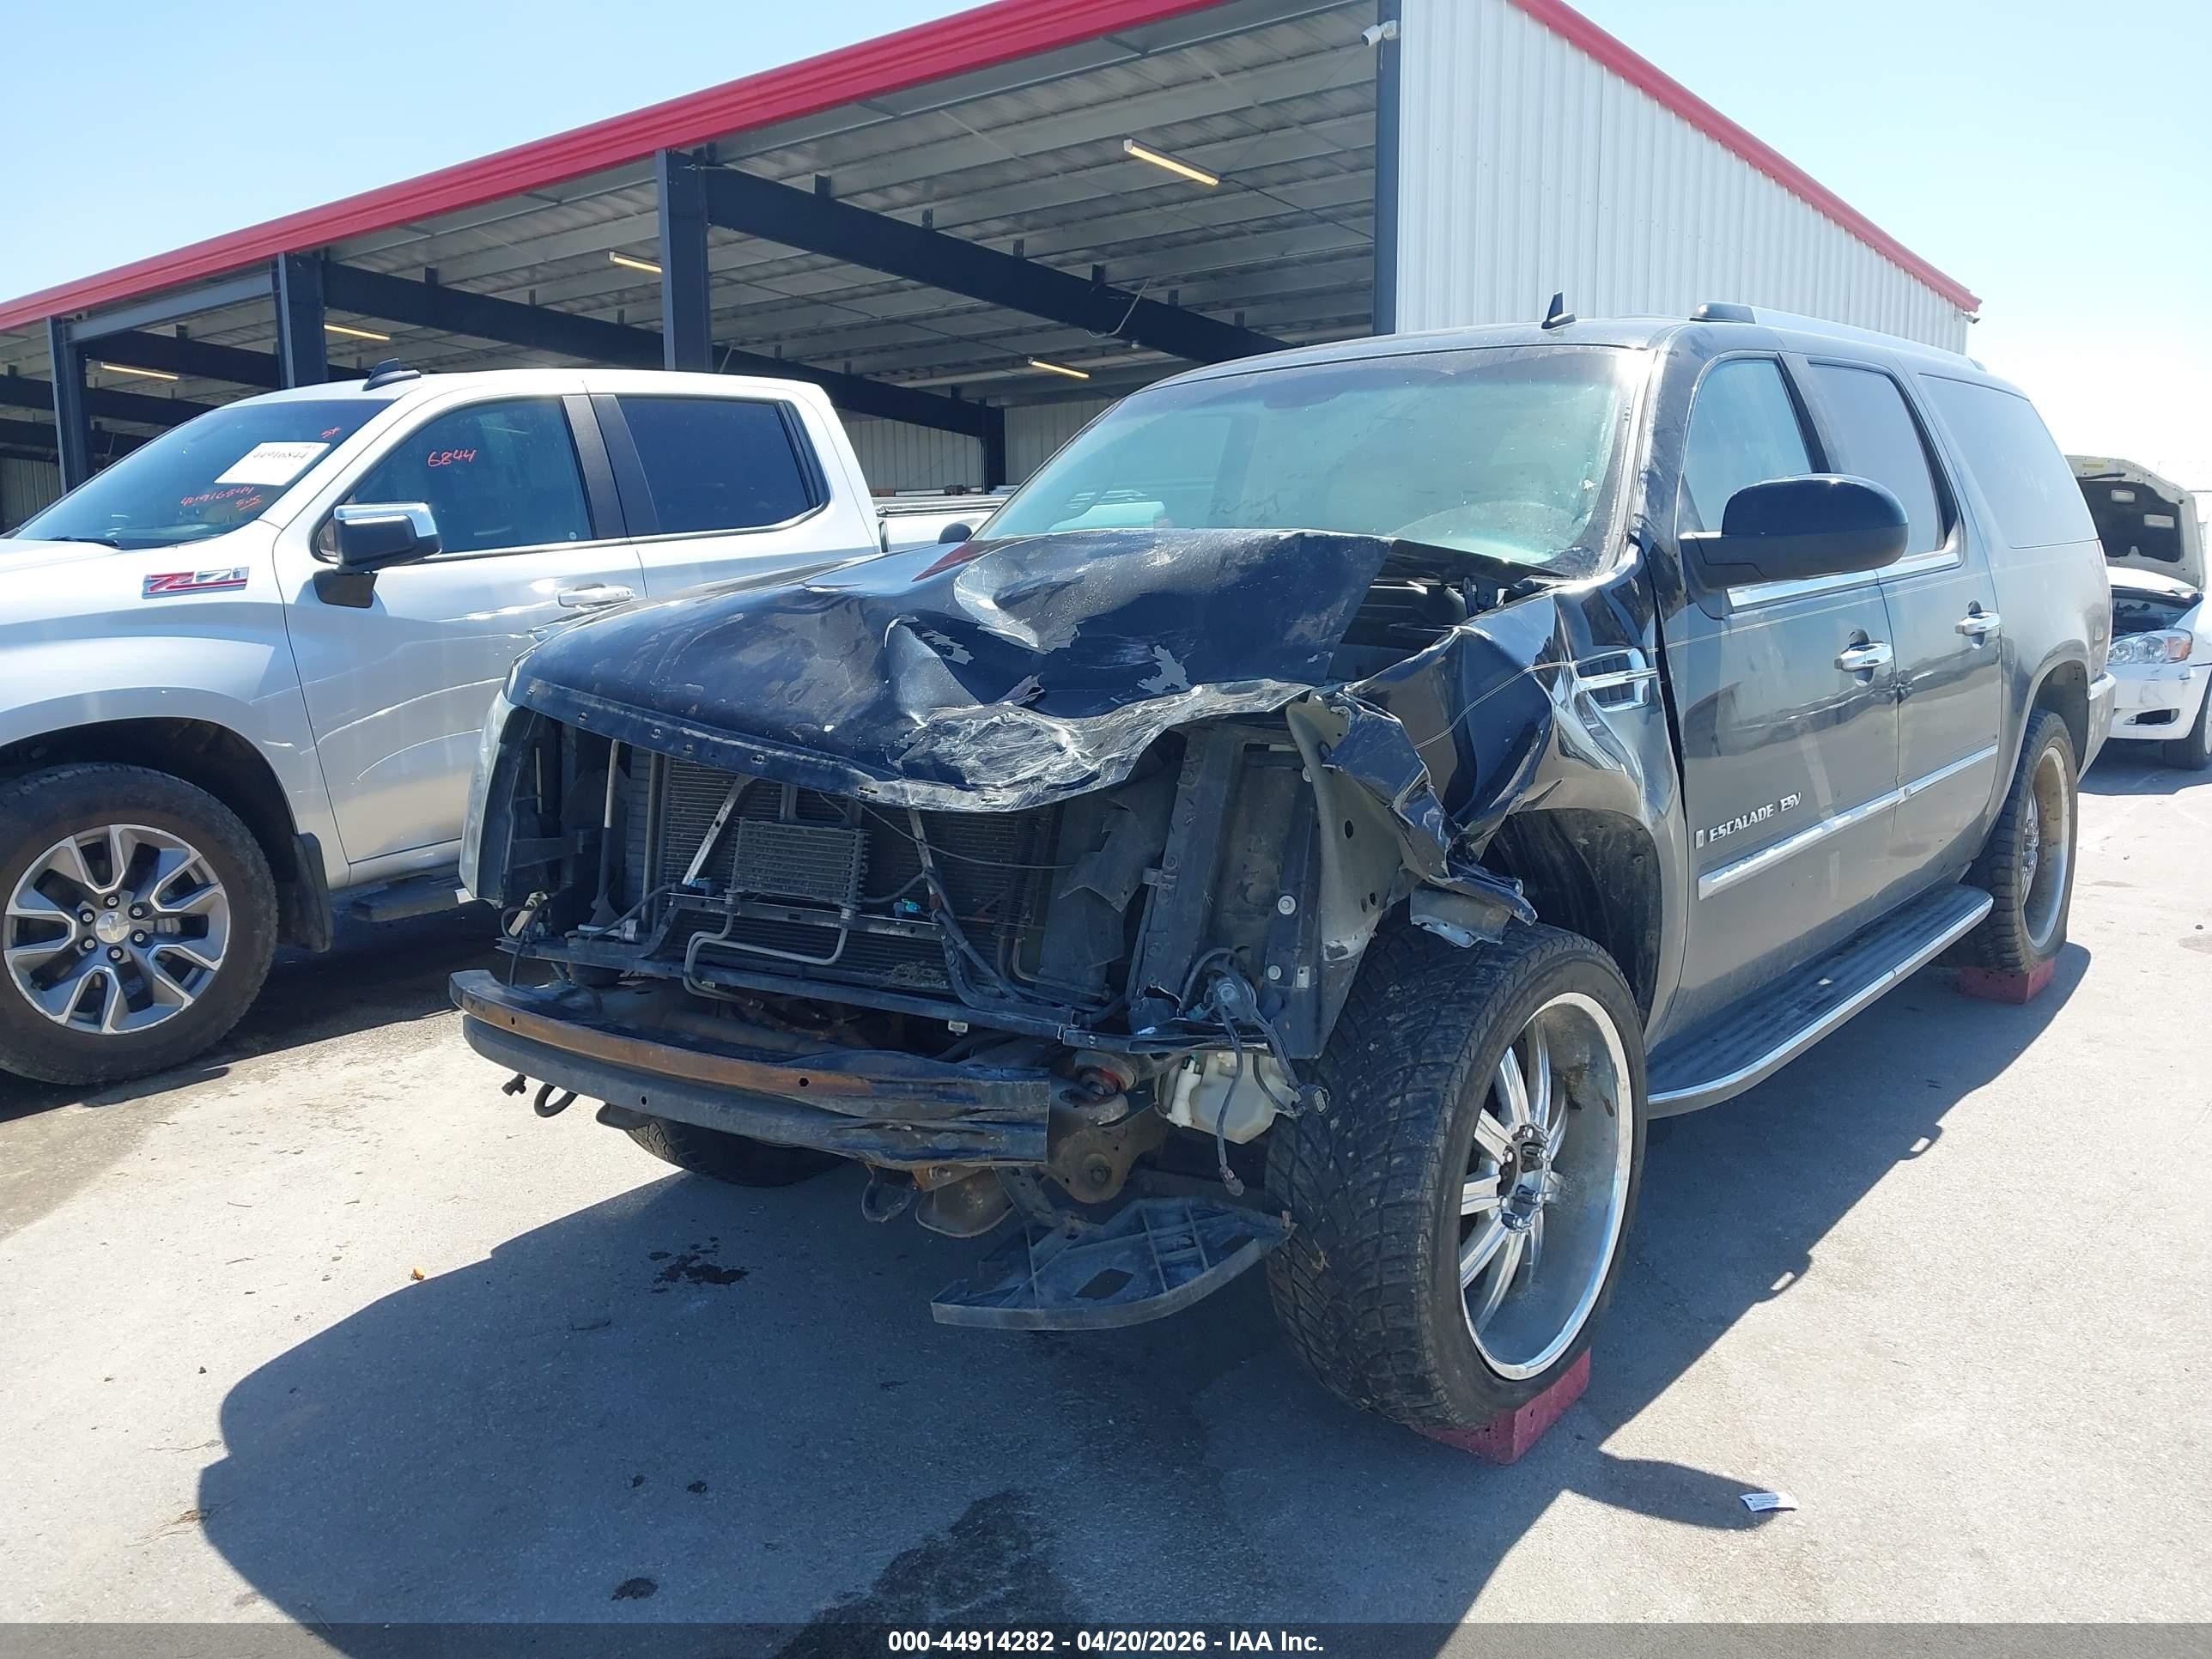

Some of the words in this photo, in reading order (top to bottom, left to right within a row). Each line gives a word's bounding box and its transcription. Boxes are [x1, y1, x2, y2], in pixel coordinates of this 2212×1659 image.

[427, 448, 477, 467] 6844
[143, 567, 250, 595] Z71
[1709, 803, 1775, 843] ESCALADE
[1780, 792, 1802, 812] ESV
